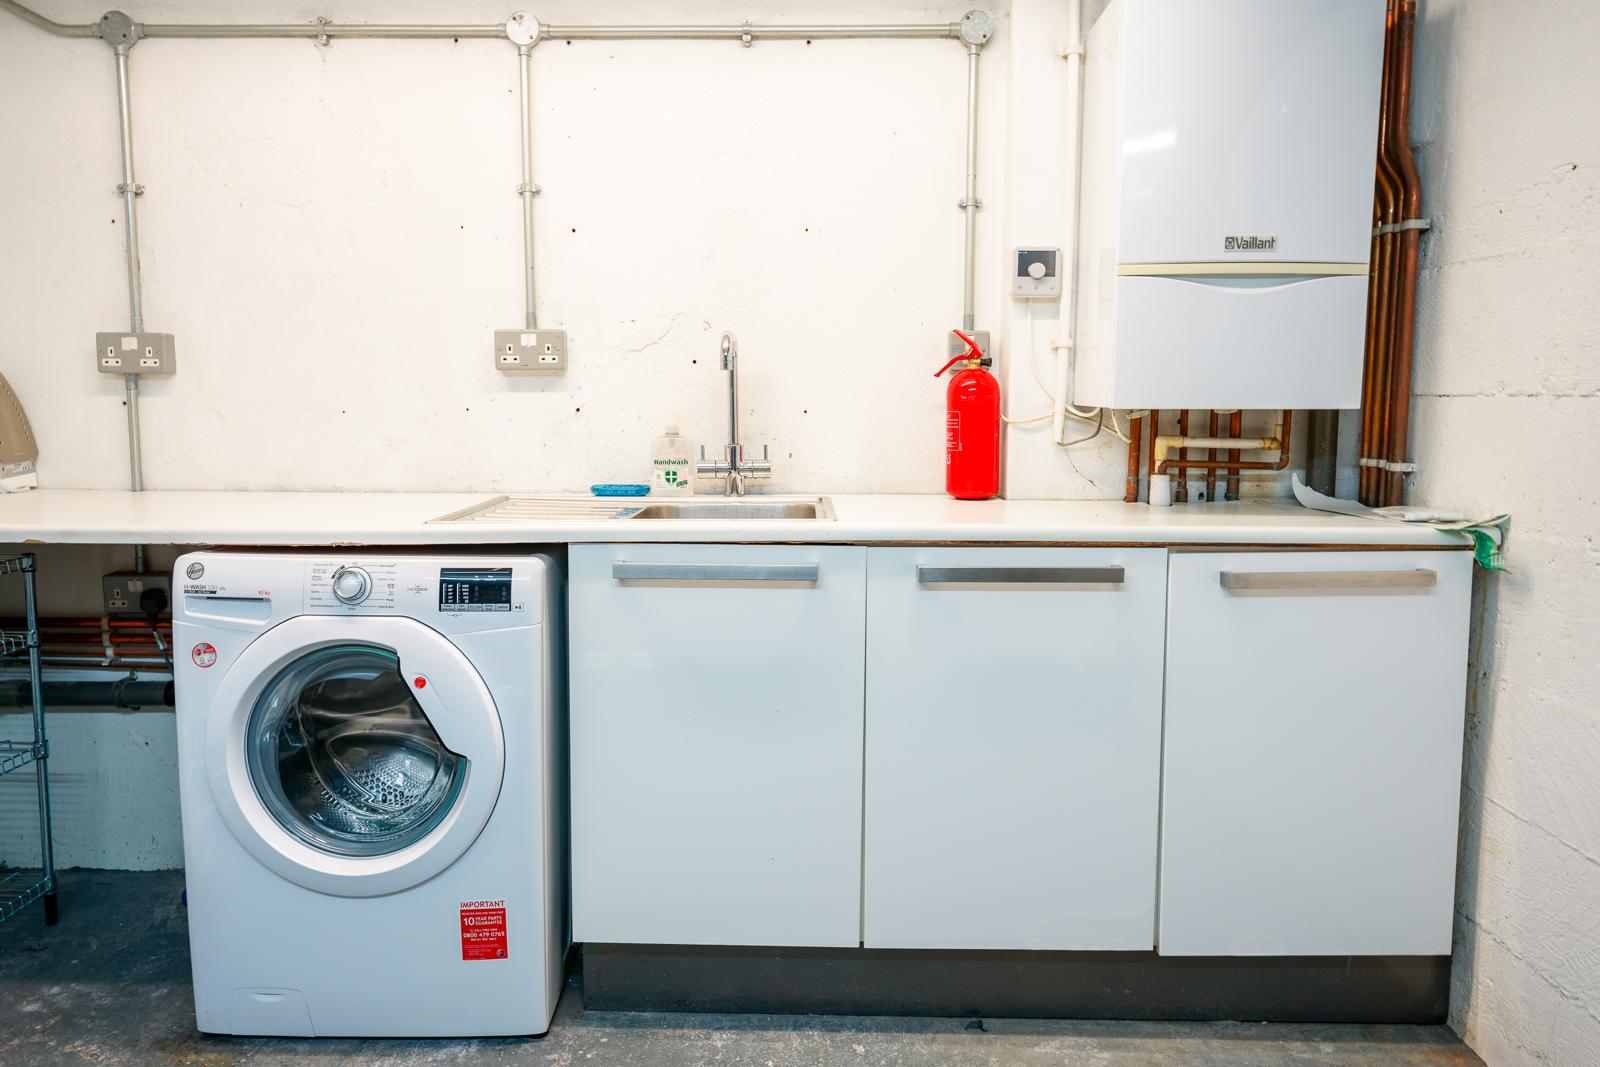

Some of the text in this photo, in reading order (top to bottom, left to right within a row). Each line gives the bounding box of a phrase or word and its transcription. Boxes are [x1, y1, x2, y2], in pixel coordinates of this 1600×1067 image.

[1235, 236, 1275, 250] Vaillant
[460, 900, 505, 908] IMPORTANT
[463, 917, 475, 926] 10
